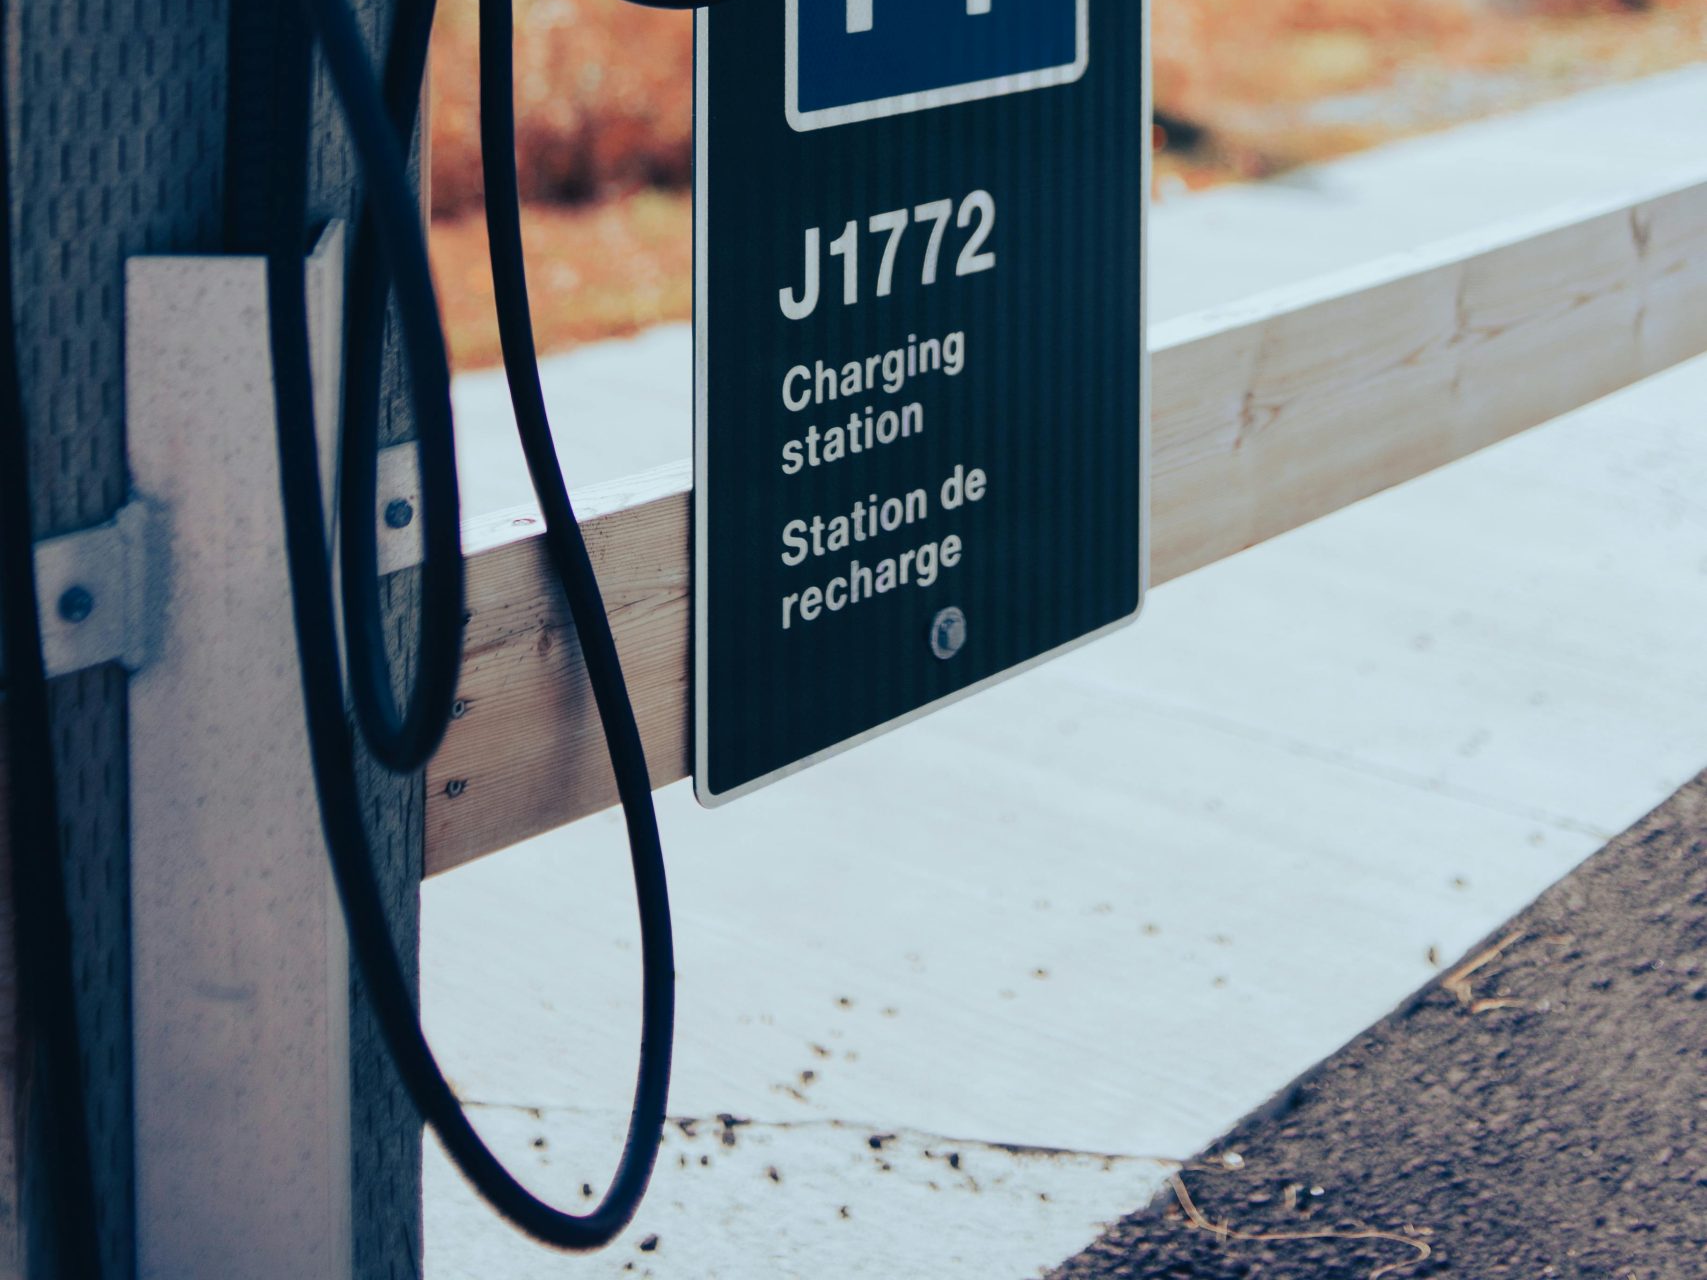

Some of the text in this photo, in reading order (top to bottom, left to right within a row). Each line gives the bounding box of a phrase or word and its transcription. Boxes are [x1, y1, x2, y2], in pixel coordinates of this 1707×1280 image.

[778, 189, 996, 320] J1772
[782, 330, 965, 412] Charging
[781, 402, 924, 475] station
[781, 464, 987, 567] Station de
[782, 534, 963, 629] recharge
